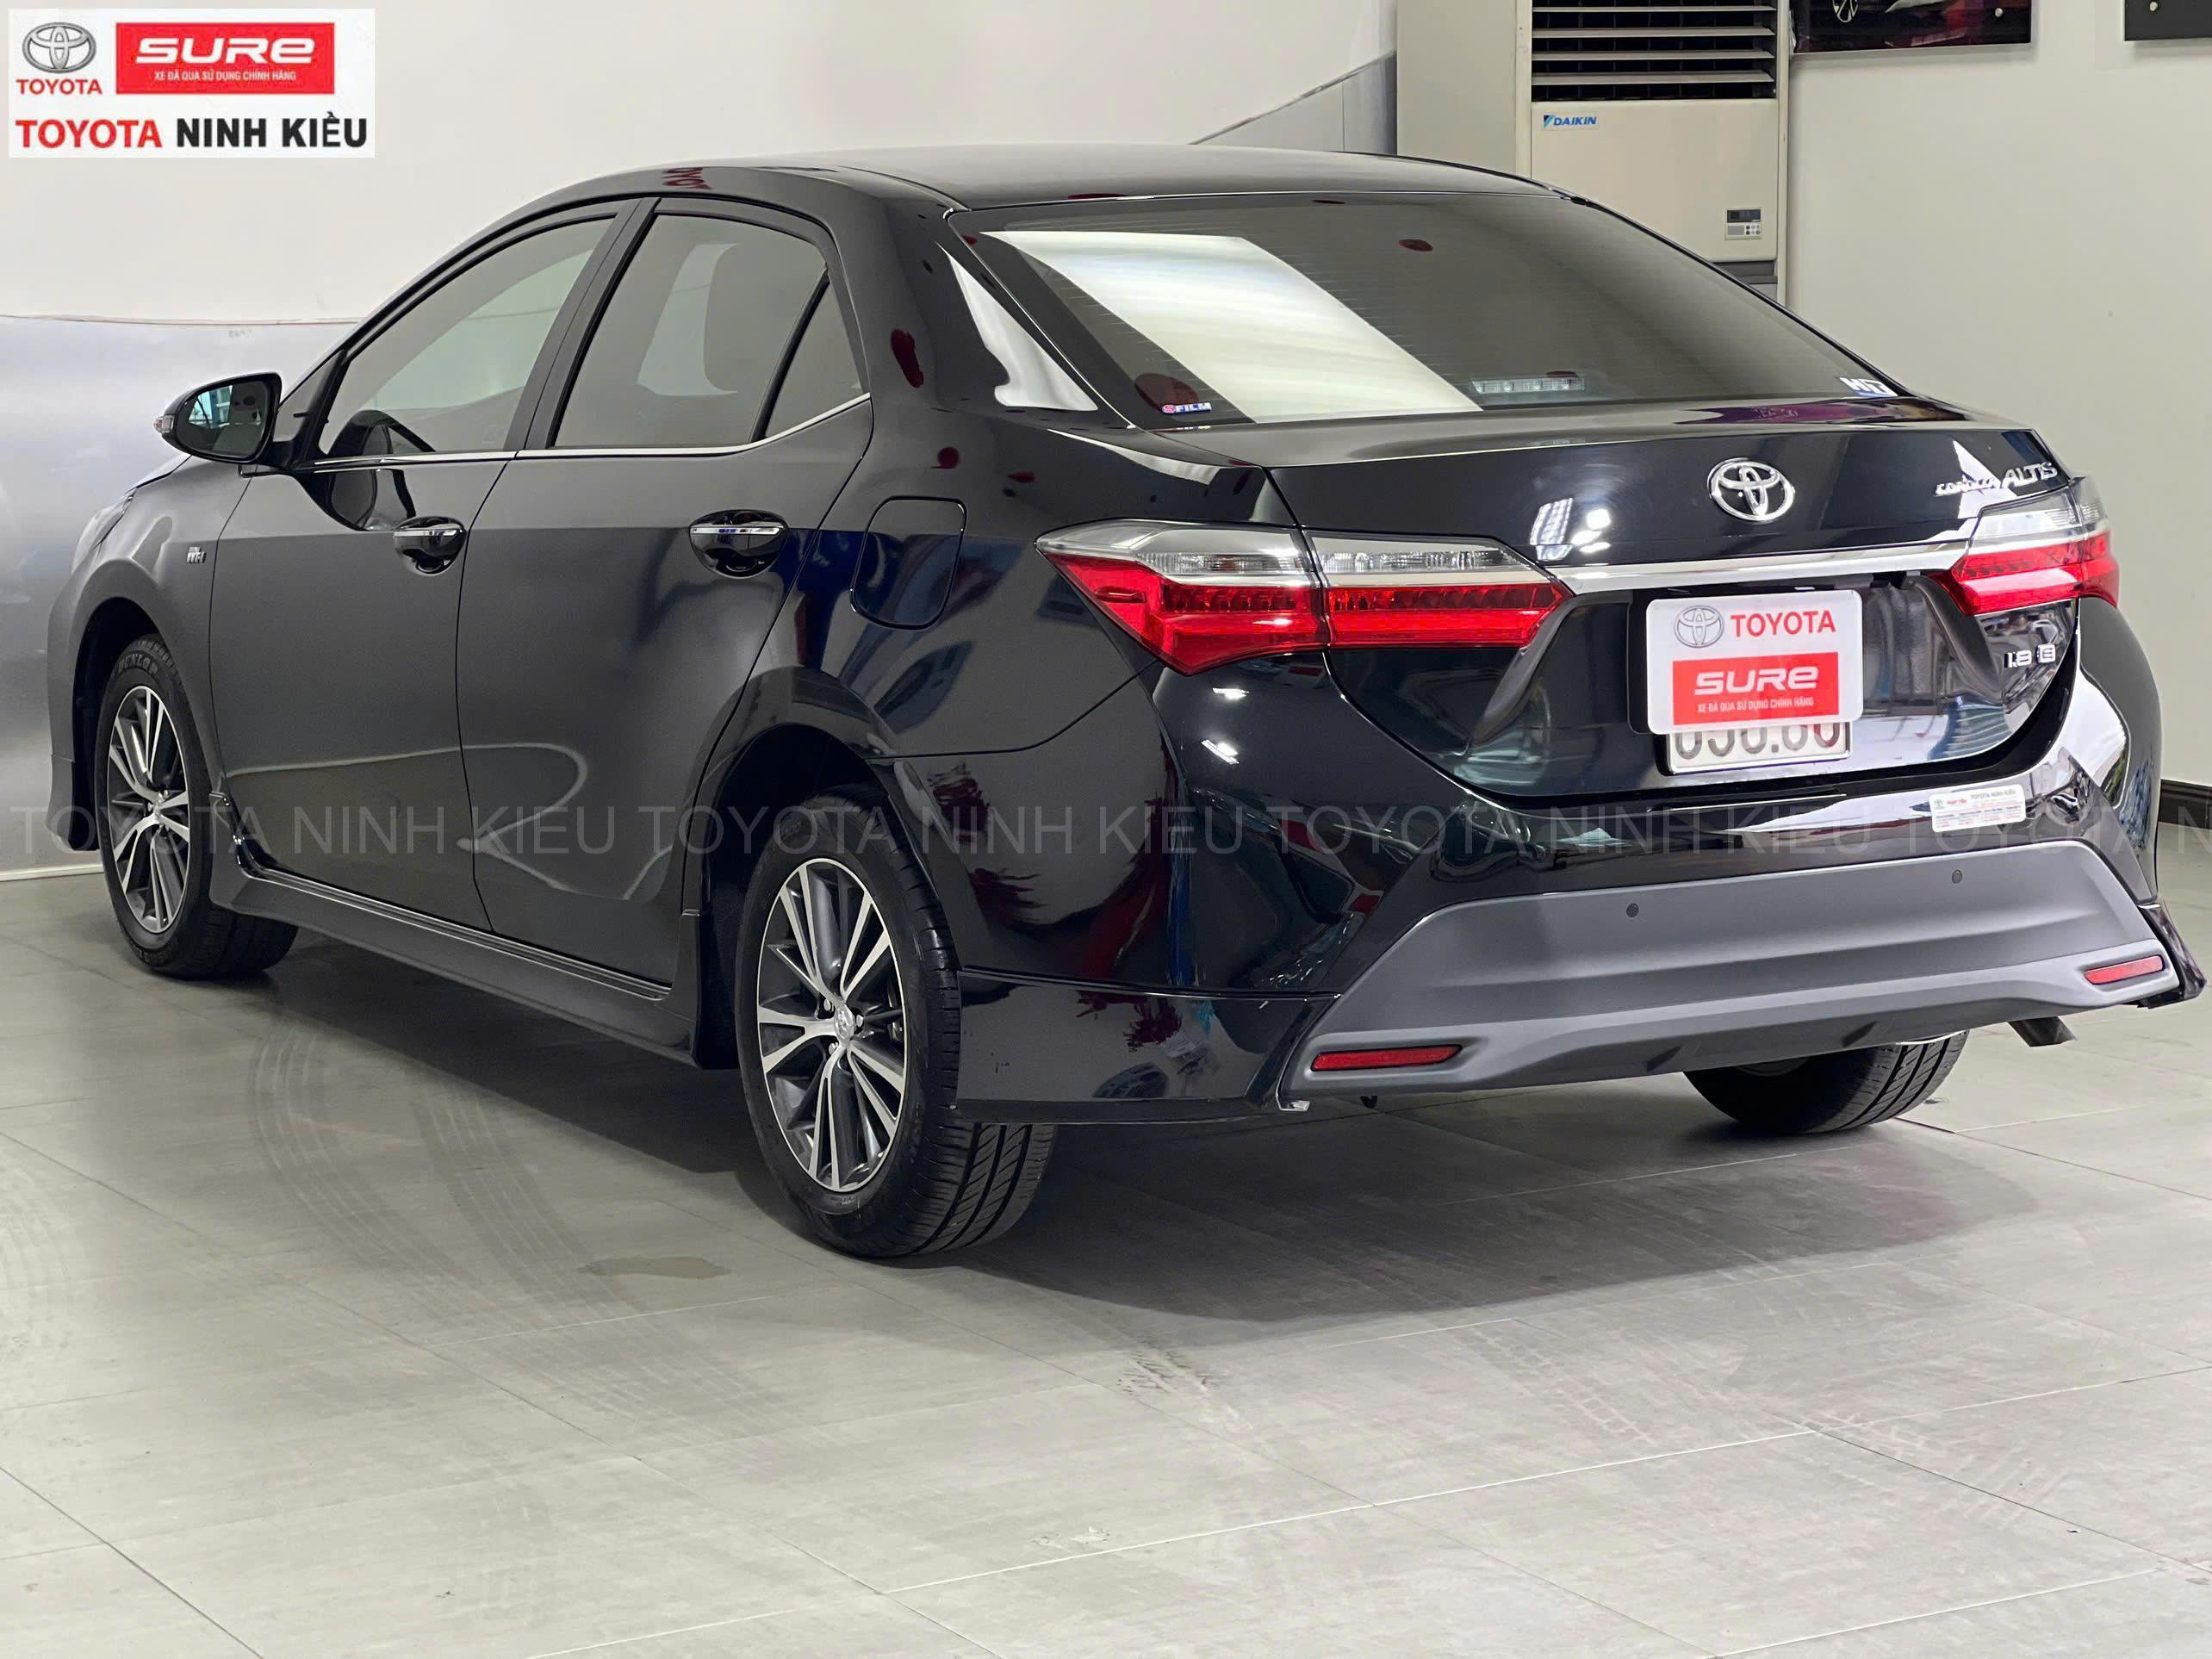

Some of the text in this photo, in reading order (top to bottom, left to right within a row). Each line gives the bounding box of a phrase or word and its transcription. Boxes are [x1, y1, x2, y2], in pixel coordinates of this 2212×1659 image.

[1553, 116, 1597, 127] DAIKIN
[2001, 461, 2058, 488] ALTIS
[1730, 610, 1836, 637] TOYOTA
[1698, 703, 1707, 713] XE
